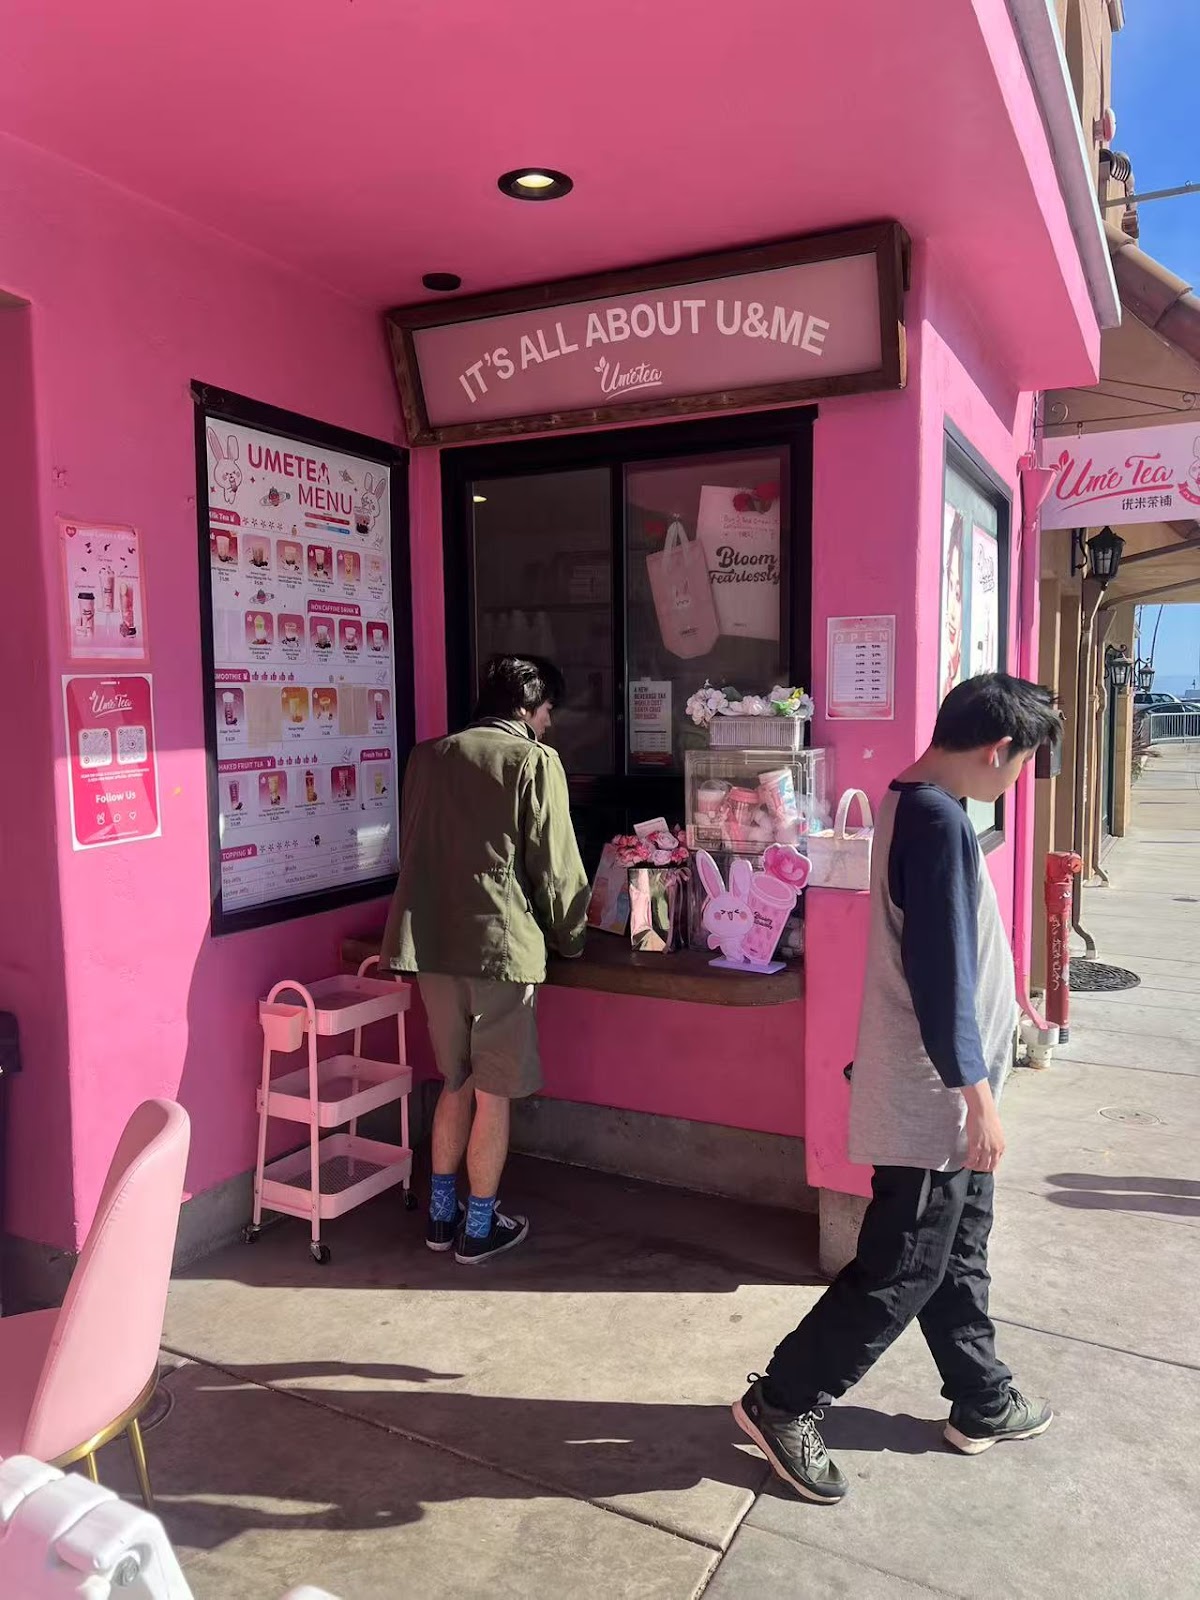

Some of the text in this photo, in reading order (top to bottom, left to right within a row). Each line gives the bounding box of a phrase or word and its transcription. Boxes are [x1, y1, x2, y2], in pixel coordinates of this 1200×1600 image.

[458, 300, 830, 403] IT'S ALL ABOUT U&ME
[248, 443, 330, 485] UMETEA
[1124, 453, 1174, 486] Tea
[298, 483, 352, 515] MENU
[716, 546, 778, 568] Bloom
[708, 565, 779, 585] Fearlessly
[835, 631, 889, 643] OPEN
[115, 694, 133, 708] Tea
[237, 761, 253, 769] FRUIT
[254, 760, 263, 768] TEA
[95, 790, 136, 803] Follow Us
[222, 849, 247, 860] TOPPING
